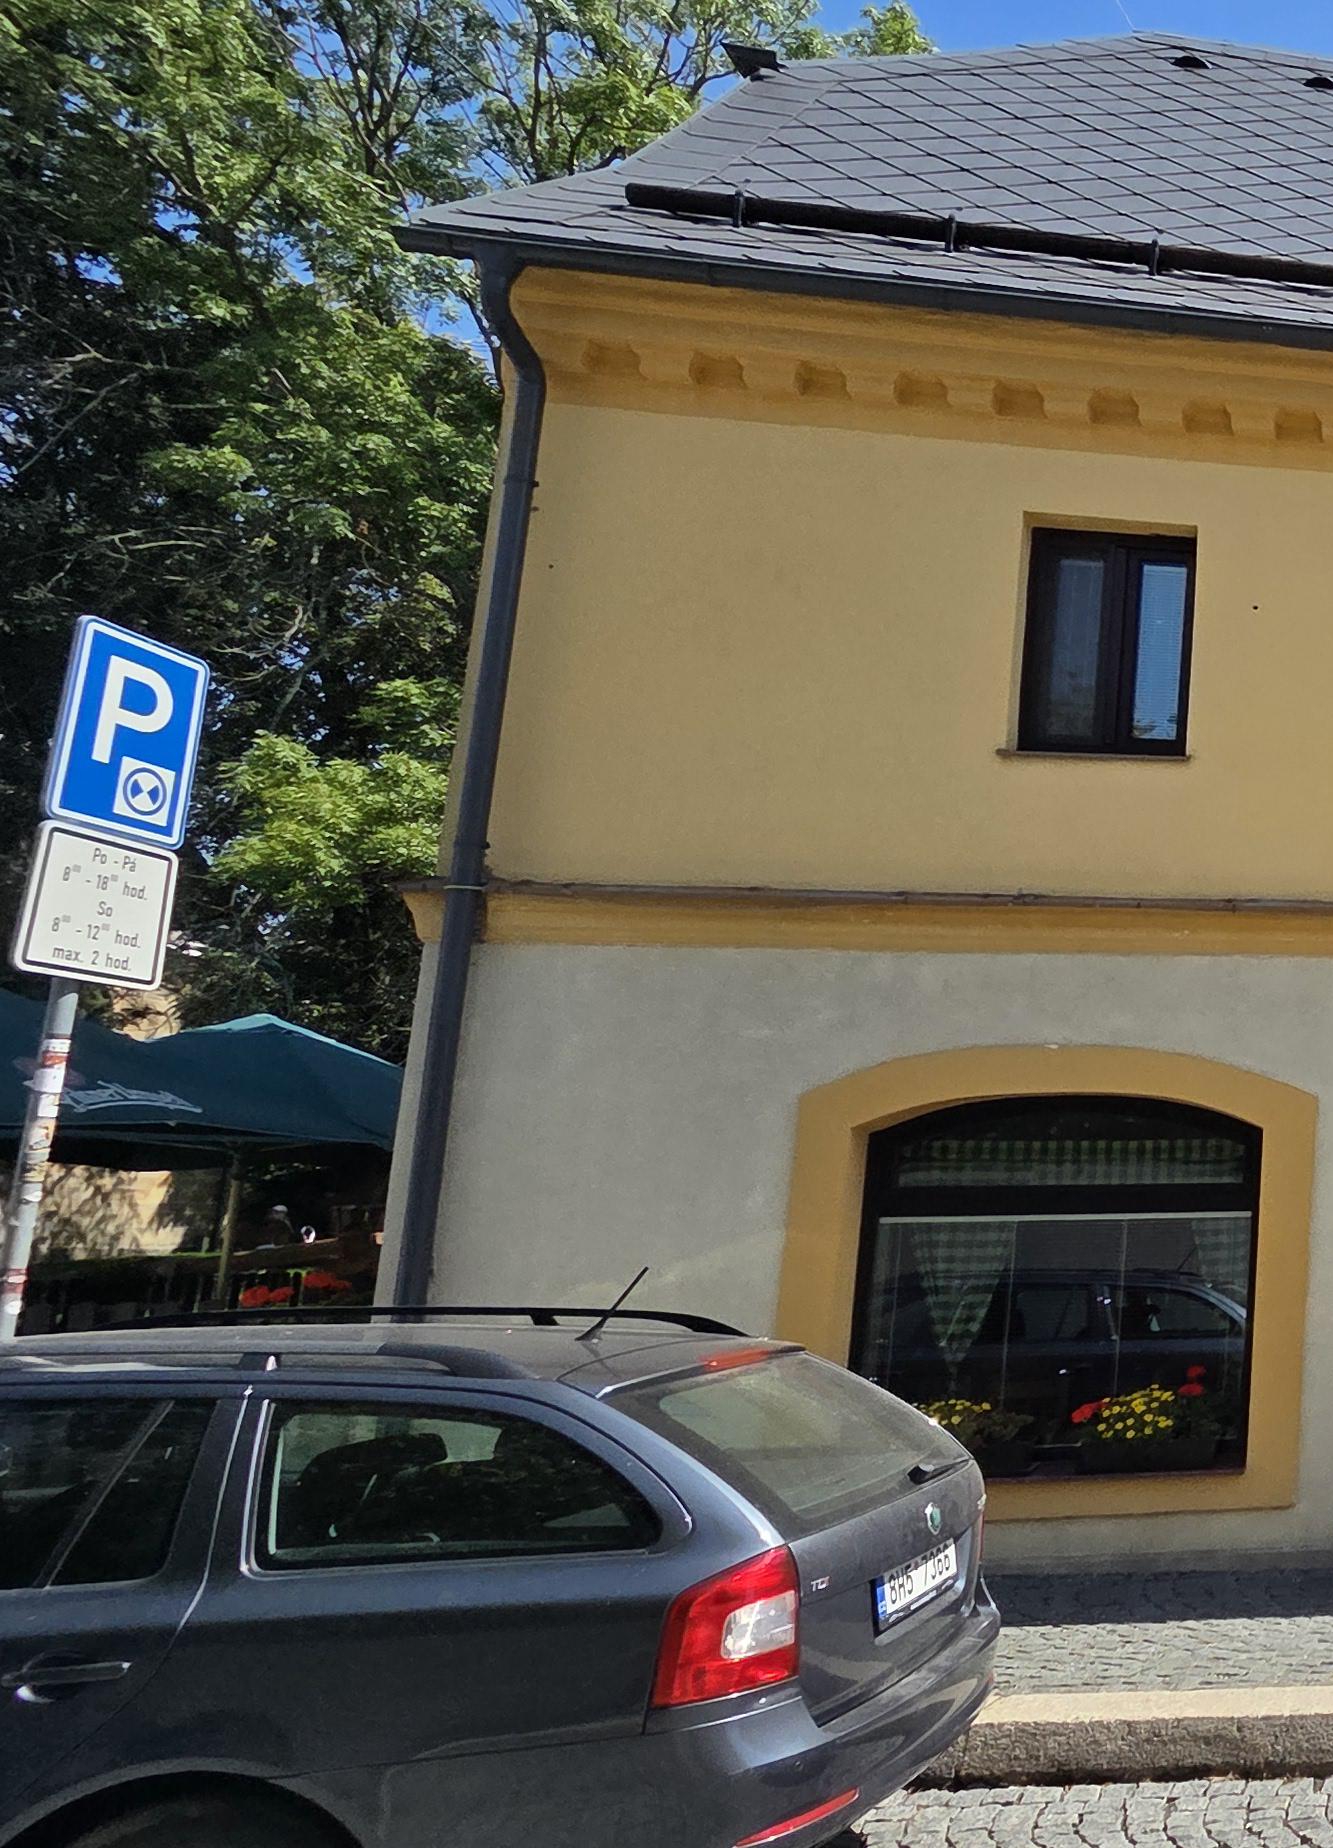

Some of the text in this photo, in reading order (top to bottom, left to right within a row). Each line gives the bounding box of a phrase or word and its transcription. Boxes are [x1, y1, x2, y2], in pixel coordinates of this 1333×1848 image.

[91, 655, 173, 764] P
[92, 848, 107, 865] Po
[121, 855, 137, 873] Pá
[122, 881, 148, 901] hod.
[97, 901, 113, 917] So
[114, 929, 141, 949] hod.
[52, 946, 131, 972] max. 2 hod.
